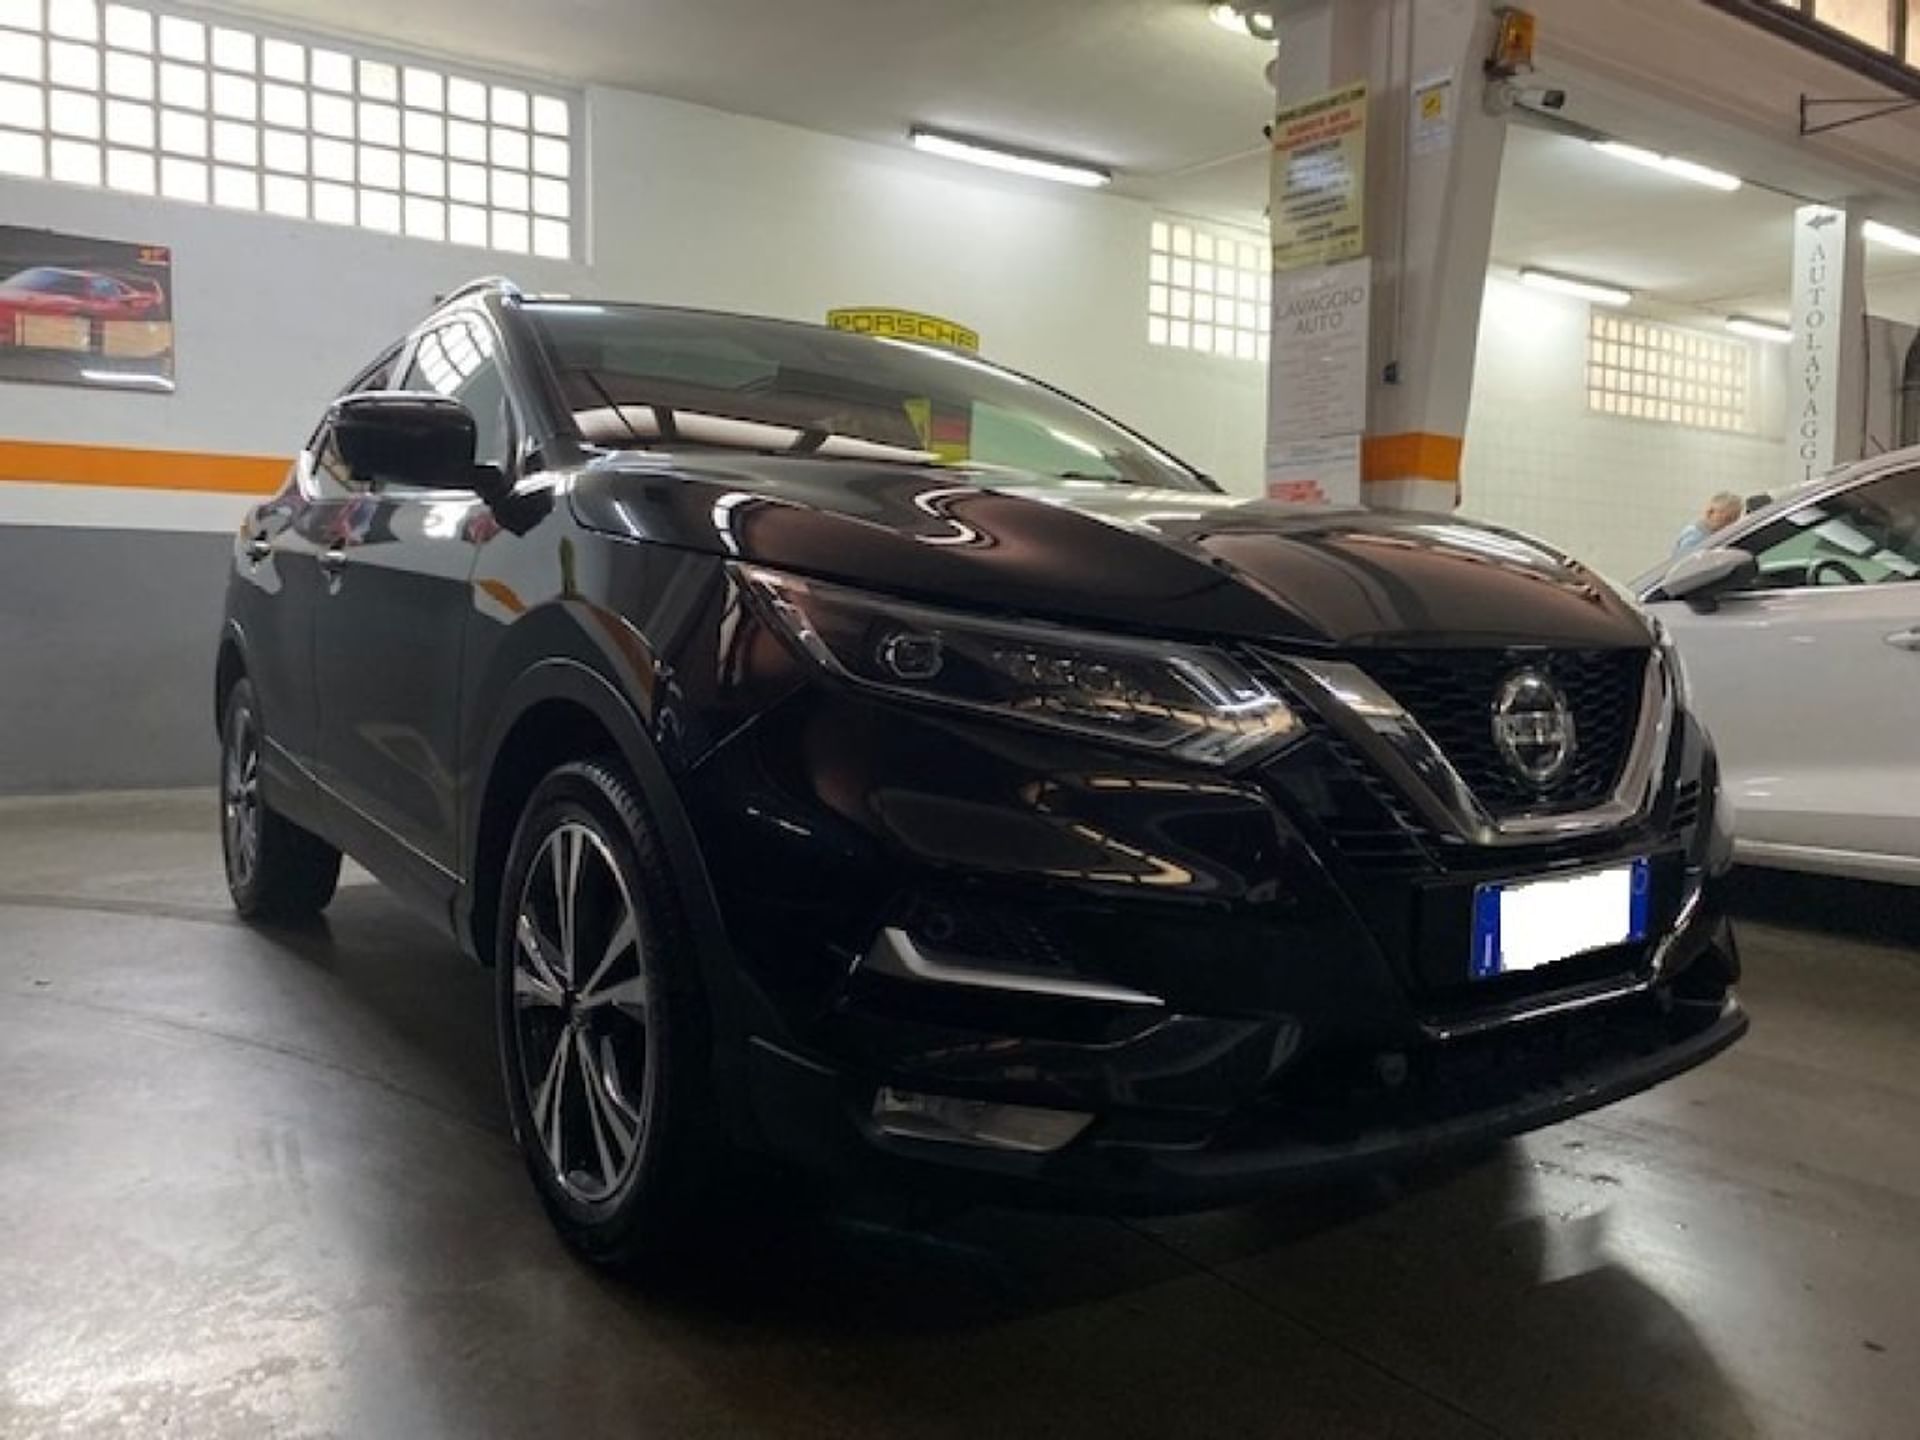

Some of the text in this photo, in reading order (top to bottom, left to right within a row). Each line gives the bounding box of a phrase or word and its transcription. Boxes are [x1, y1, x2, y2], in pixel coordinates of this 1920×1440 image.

[1276, 286, 1364, 320] LAVAGGIO
[833, 314, 974, 348] PORSCHE
[1295, 310, 1344, 336] AUTO
